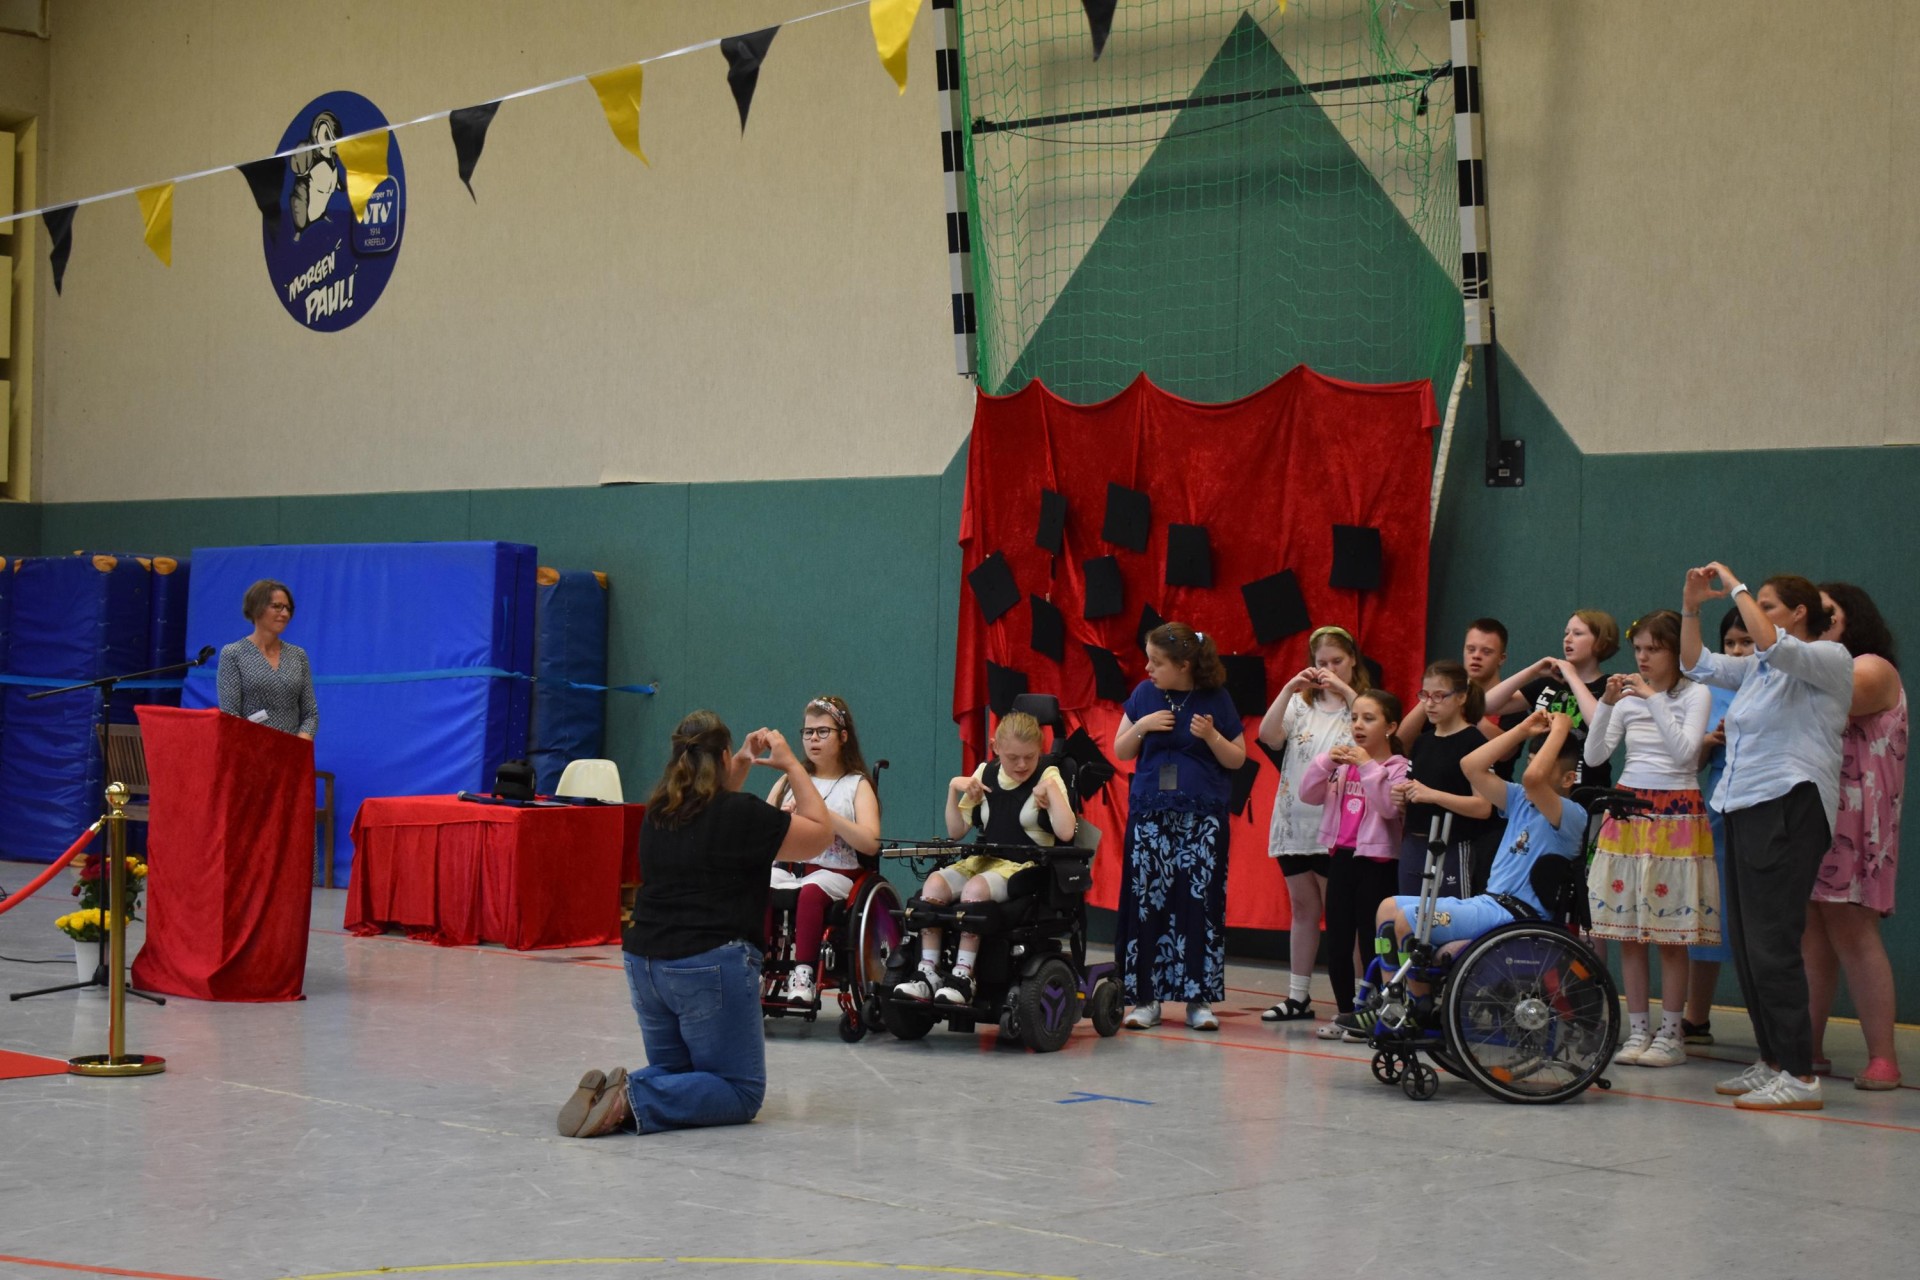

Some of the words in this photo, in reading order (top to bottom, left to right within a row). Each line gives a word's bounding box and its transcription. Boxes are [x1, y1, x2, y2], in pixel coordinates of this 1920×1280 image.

[386, 189, 394, 197] TV
[364, 237, 386, 247] KREFELD
[305, 273, 355, 324] PAUL!
